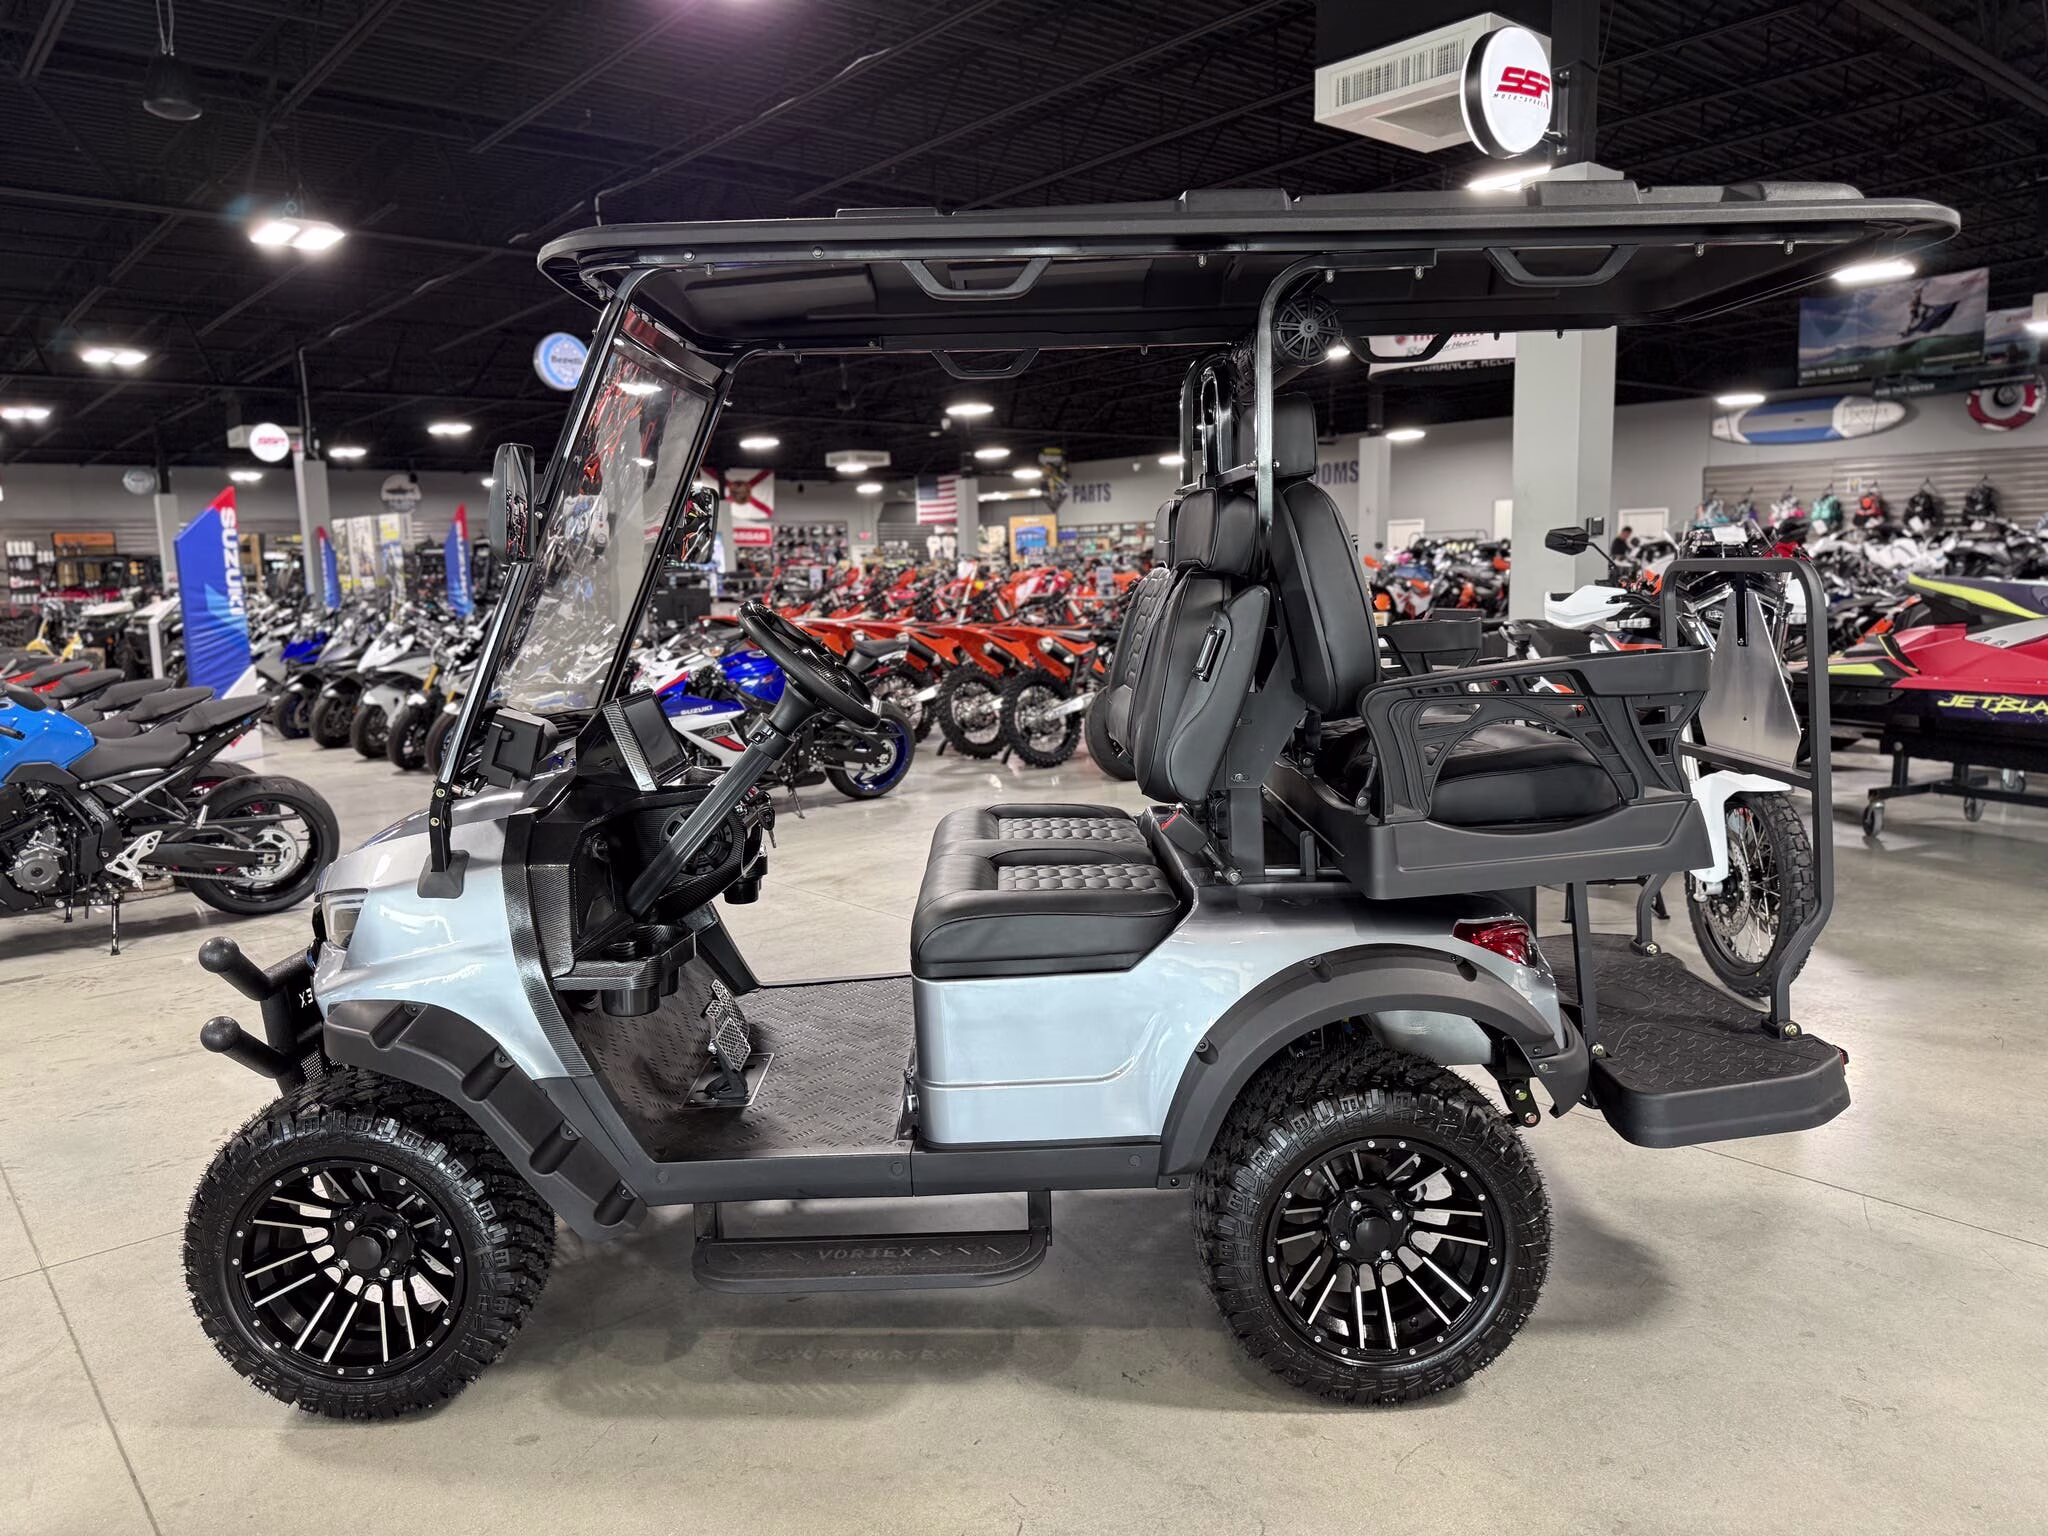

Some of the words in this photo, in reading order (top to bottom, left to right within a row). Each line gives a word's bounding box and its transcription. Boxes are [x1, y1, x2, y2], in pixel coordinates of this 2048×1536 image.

[1072, 482, 1112, 503] PARTS
[220, 506, 244, 616] SUZUKI
[680, 704, 713, 716] SUZUKI
[818, 1246, 913, 1261] VORTEX
